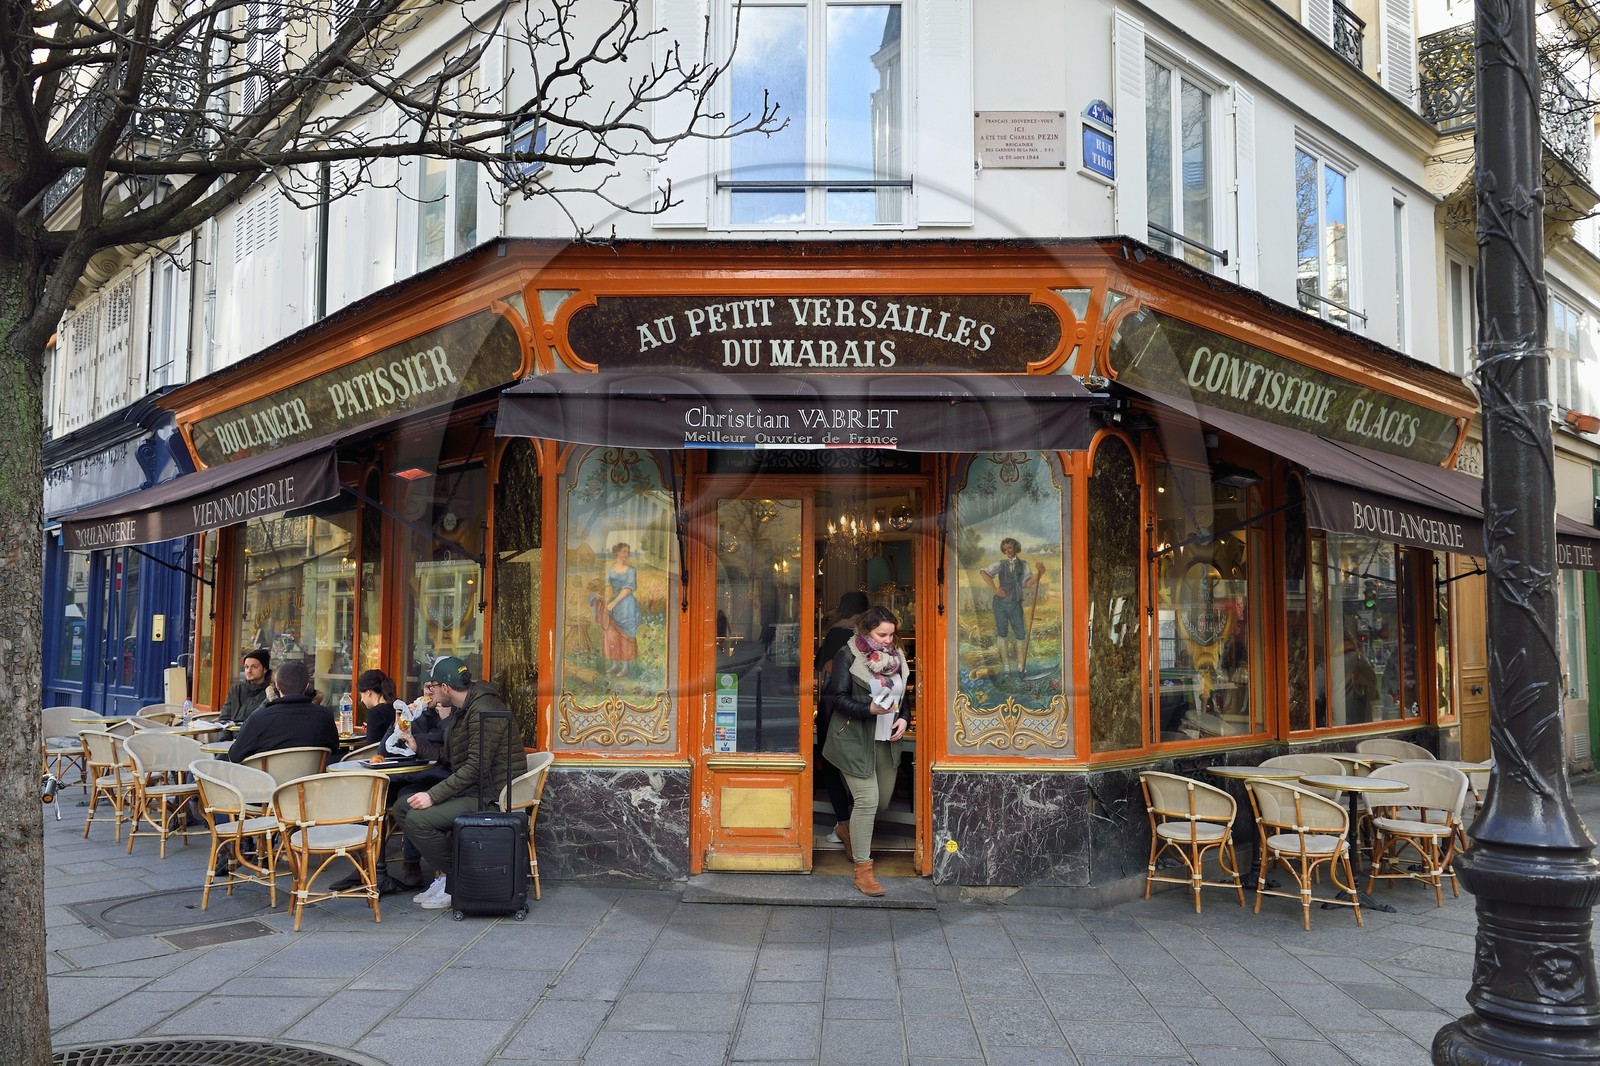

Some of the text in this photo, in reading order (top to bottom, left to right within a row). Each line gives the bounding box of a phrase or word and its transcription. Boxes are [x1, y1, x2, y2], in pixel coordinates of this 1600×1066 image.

[1096, 138, 1113, 156] RUE
[1092, 152, 1113, 172] TIRO
[637, 297, 997, 354] AU PETIT VERSAILLES
[721, 339, 897, 368] DU MARAIS
[214, 345, 457, 455] BOULANGER PATISSIER
[1187, 346, 1421, 448] CONFISERIE GLACES
[685, 406, 899, 429] Christian VABRET
[684, 431, 898, 445] Meilleur Ouvrier de France
[192, 476, 295, 528] VIENNOISERIE
[1352, 501, 1464, 548] BOULANGERIE
[1557, 541, 1594, 566] DE THÉ
